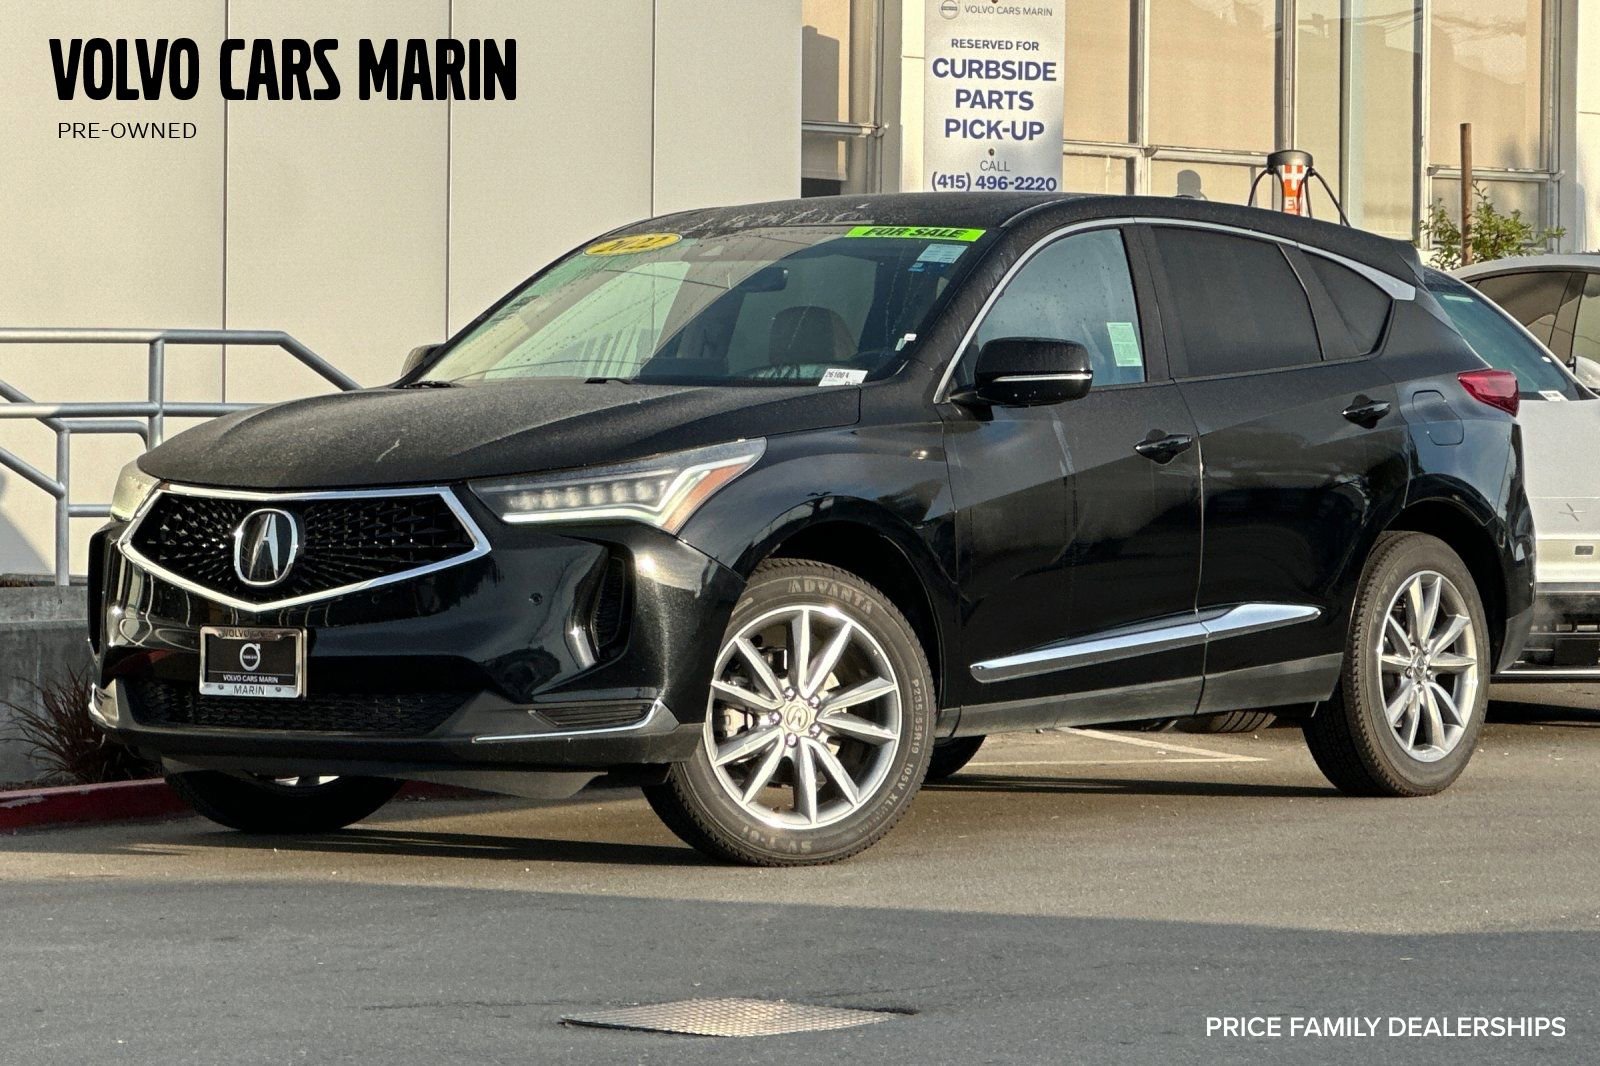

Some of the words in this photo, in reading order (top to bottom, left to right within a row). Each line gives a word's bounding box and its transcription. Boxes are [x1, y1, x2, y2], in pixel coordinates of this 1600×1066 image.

[964, 5, 995, 15] VOLVO
[996, 6, 1021, 16] CARS
[1022, 7, 1053, 17] MARIN
[951, 38, 1013, 50] RESERVED
[1015, 41, 1040, 51] FOR
[932, 57, 1057, 82] CURBSIDE
[955, 88, 1035, 111] PARTS
[945, 118, 1045, 141] PICK-UP
[979, 160, 1011, 172] CALL
[931, 171, 972, 192] (415)
[975, 175, 1057, 192] 496-2220
[862, 227, 907, 237] FOR
[909, 227, 967, 239] SALE
[788, 580, 873, 615] ADVANTA
[223, 673, 242, 683] VOLVO
[242, 674, 258, 683] CARS
[259, 675, 279, 684] MARIN
[233, 685, 265, 695] MARIN
[884, 792, 898, 806] XL
